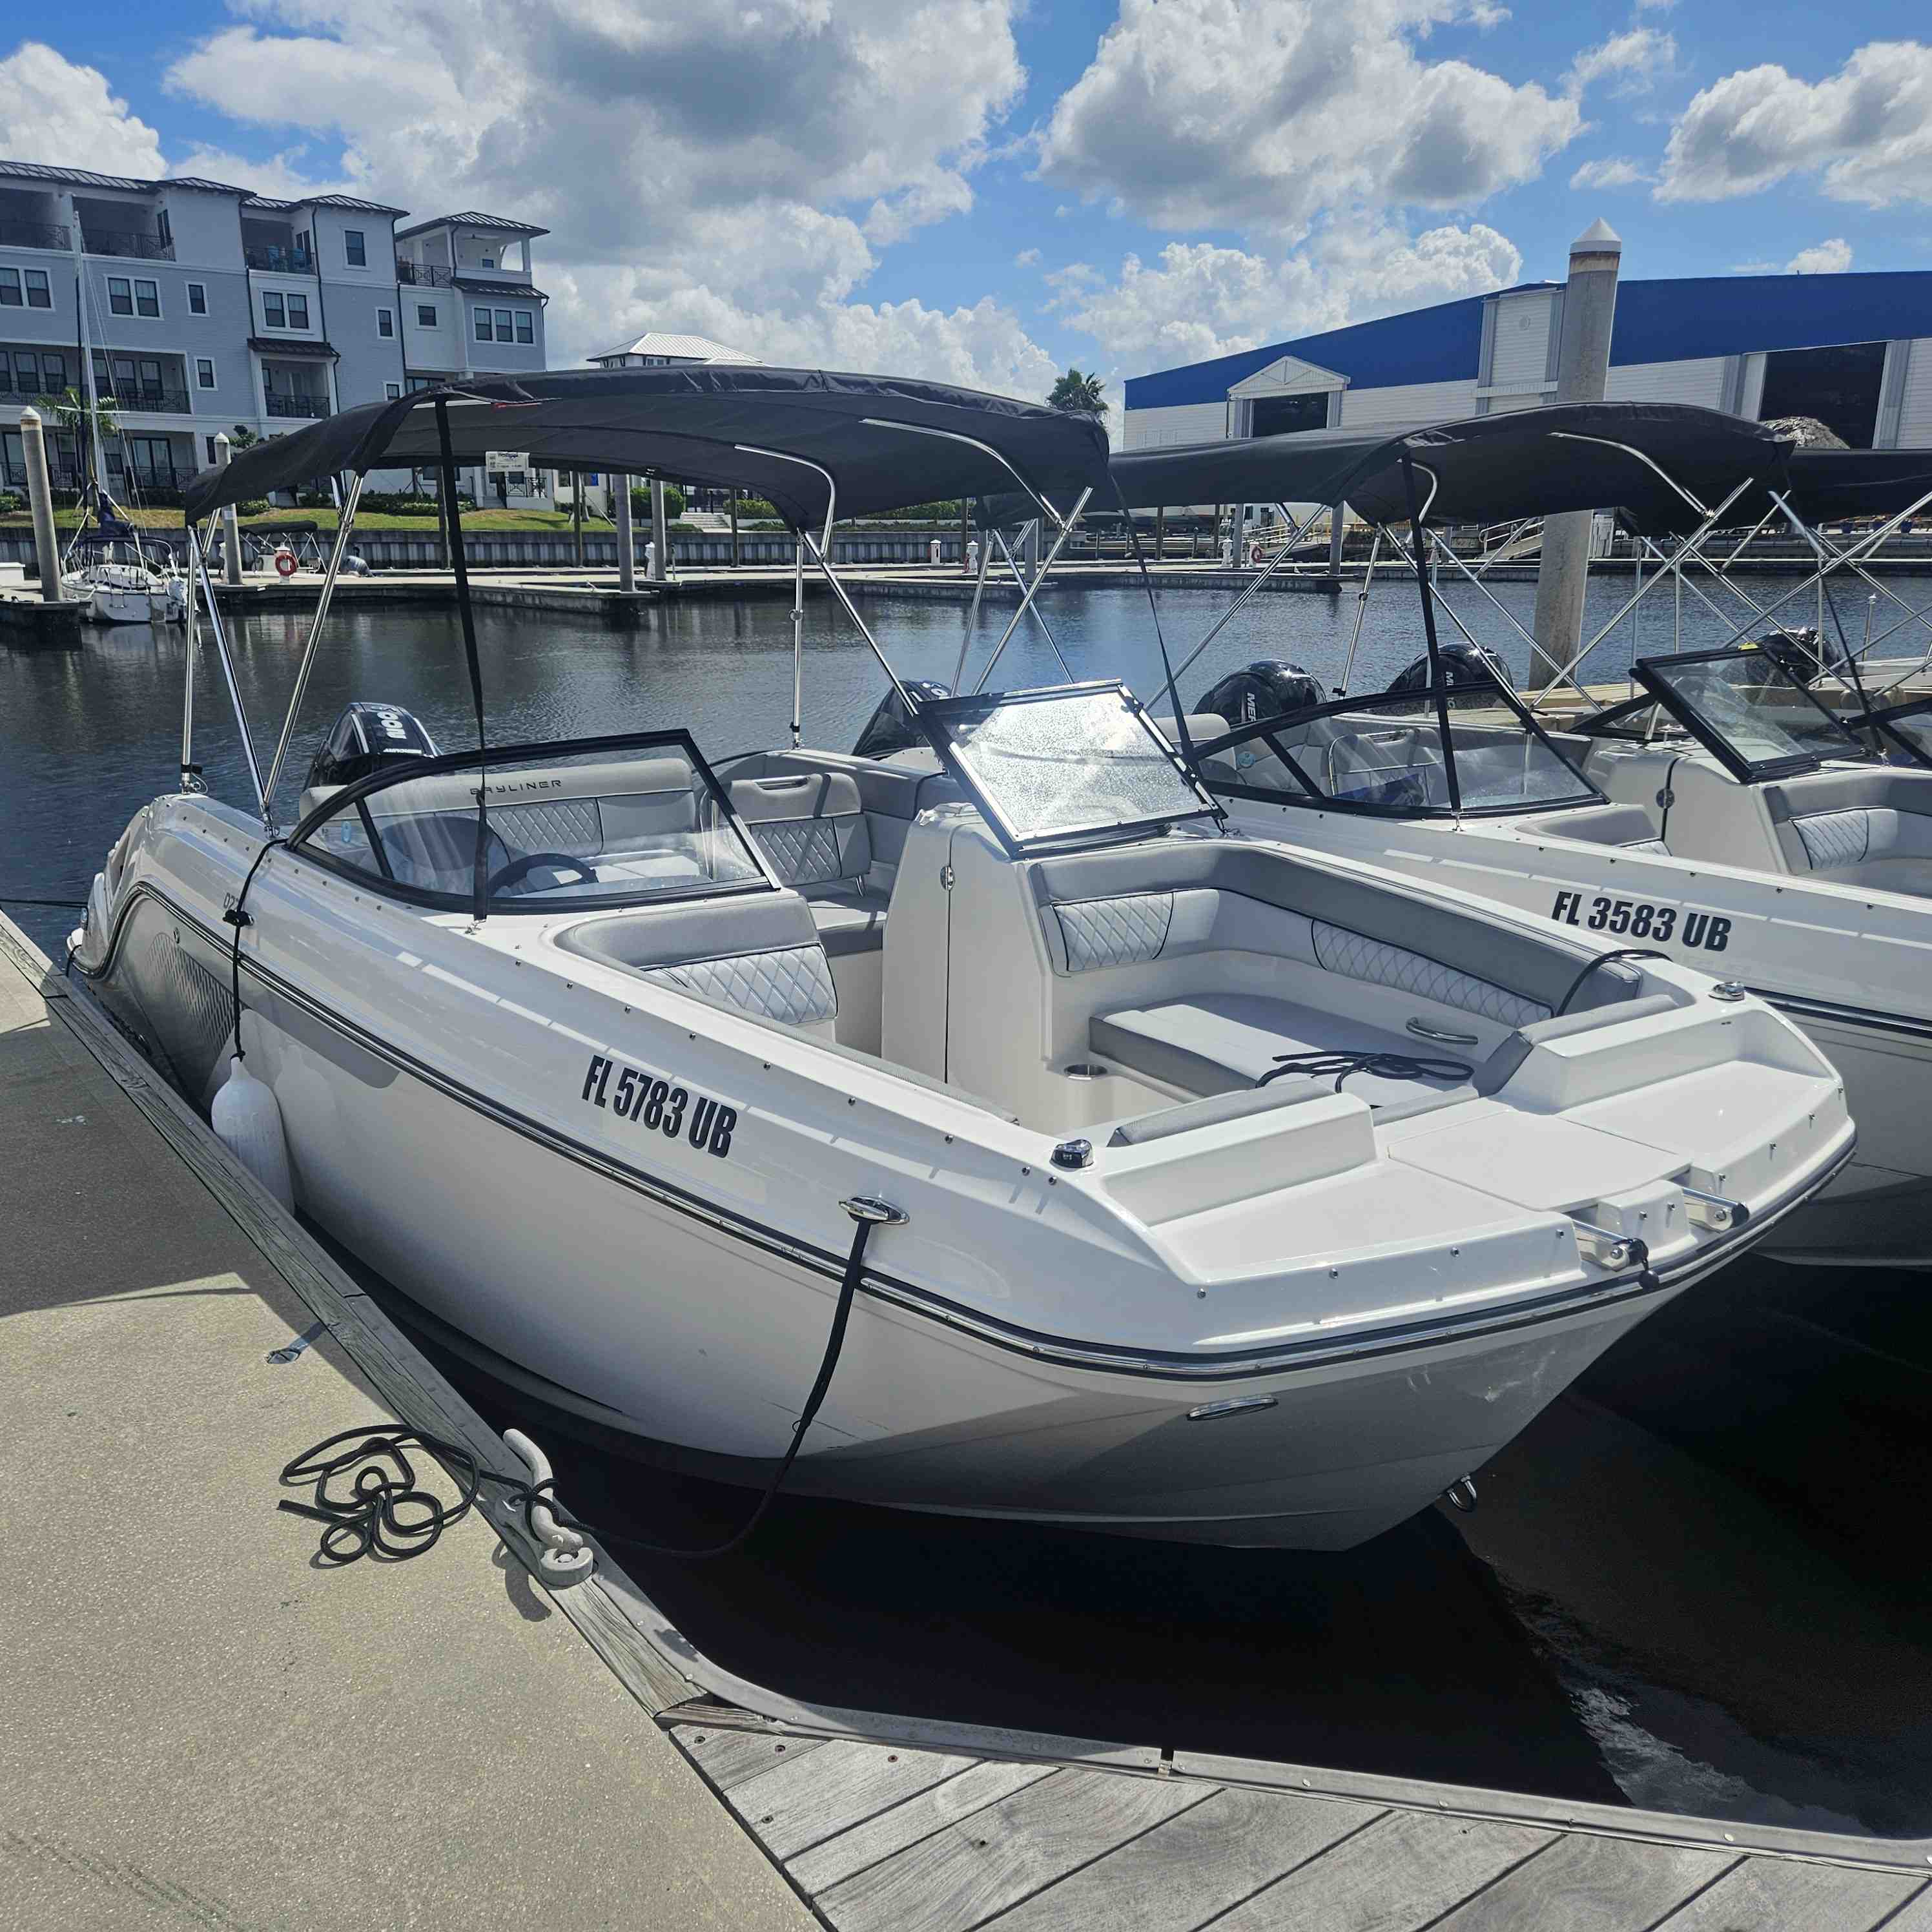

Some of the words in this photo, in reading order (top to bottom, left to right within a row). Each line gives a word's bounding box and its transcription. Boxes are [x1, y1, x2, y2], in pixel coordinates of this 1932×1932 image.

[1551, 890, 1582, 926] FL
[1587, 896, 1677, 942] 3583
[1681, 912, 1731, 952] UB
[582, 1054, 613, 1108] FL
[613, 1067, 688, 1138] 5783
[688, 1096, 737, 1158] UB
